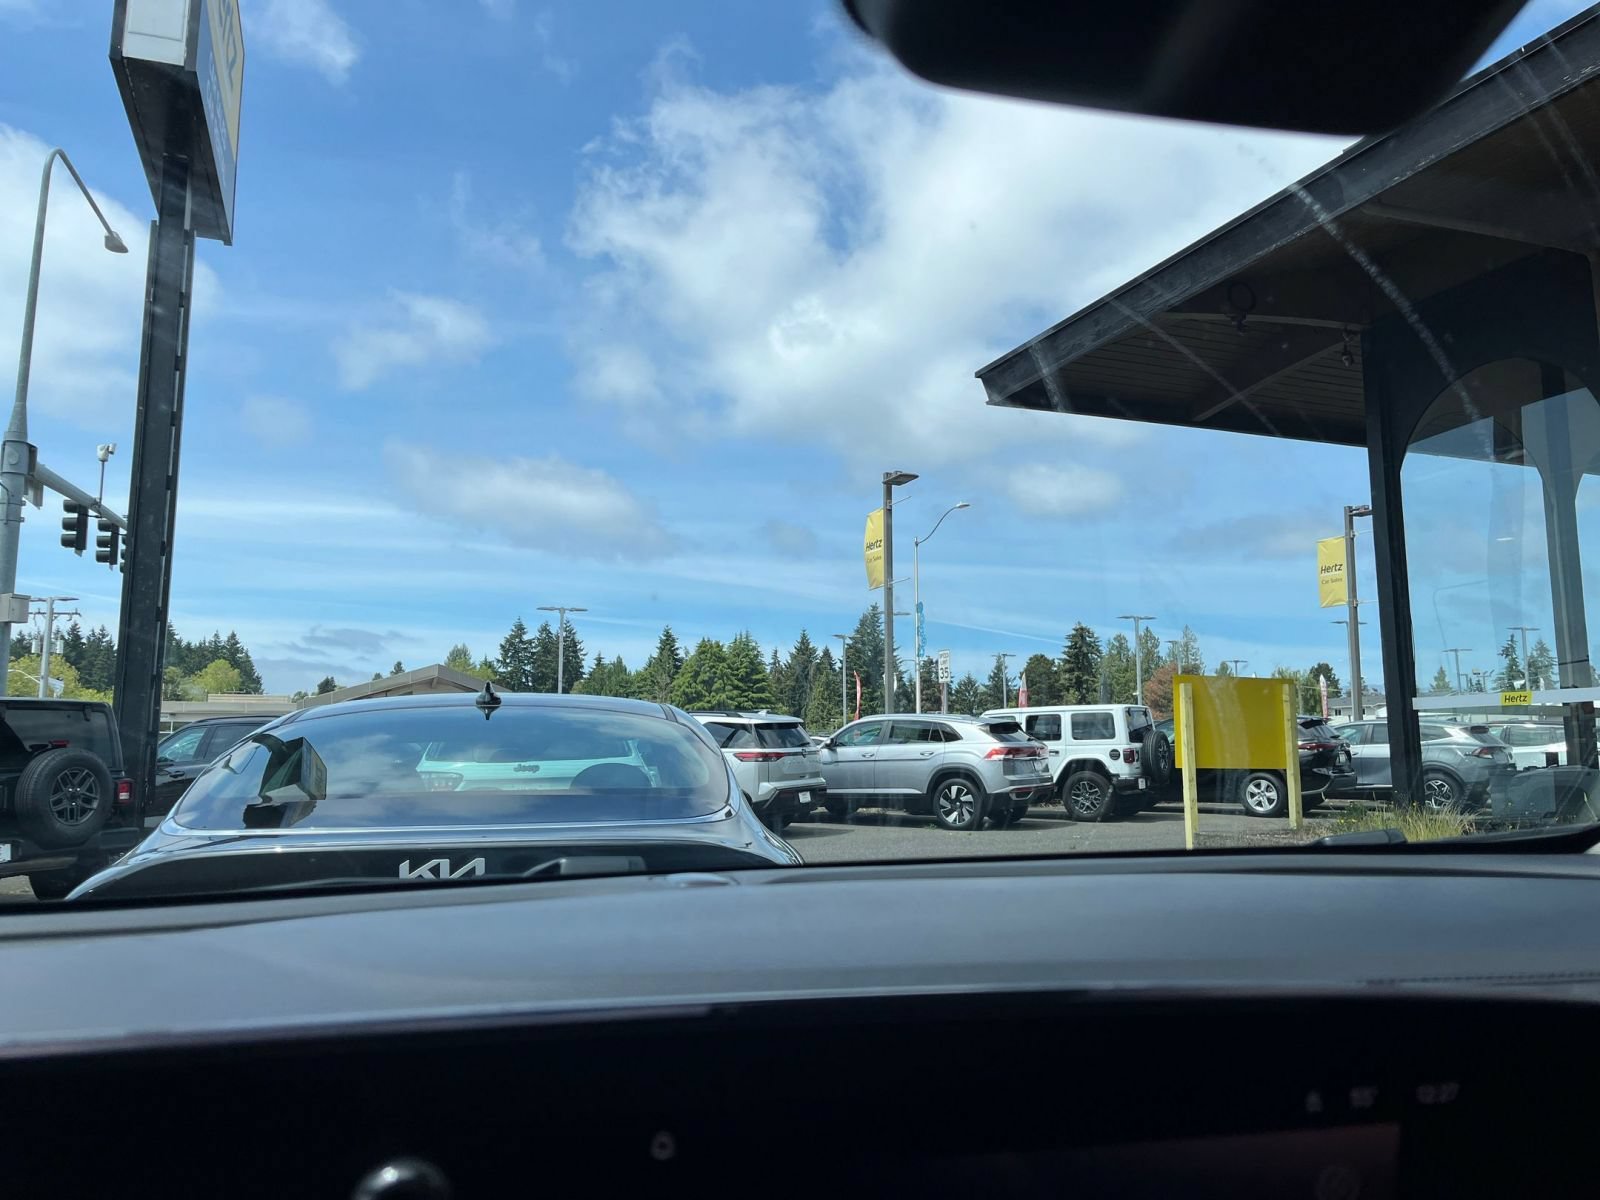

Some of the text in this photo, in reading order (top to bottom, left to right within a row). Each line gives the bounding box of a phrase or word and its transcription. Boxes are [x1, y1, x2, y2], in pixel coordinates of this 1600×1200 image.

[866, 539, 883, 552] Hertz
[1320, 563, 1343, 574] Hertz
[940, 667, 949, 679] 35
[1504, 694, 1528, 703] Hertz
[513, 763, 540, 774] Jeep
